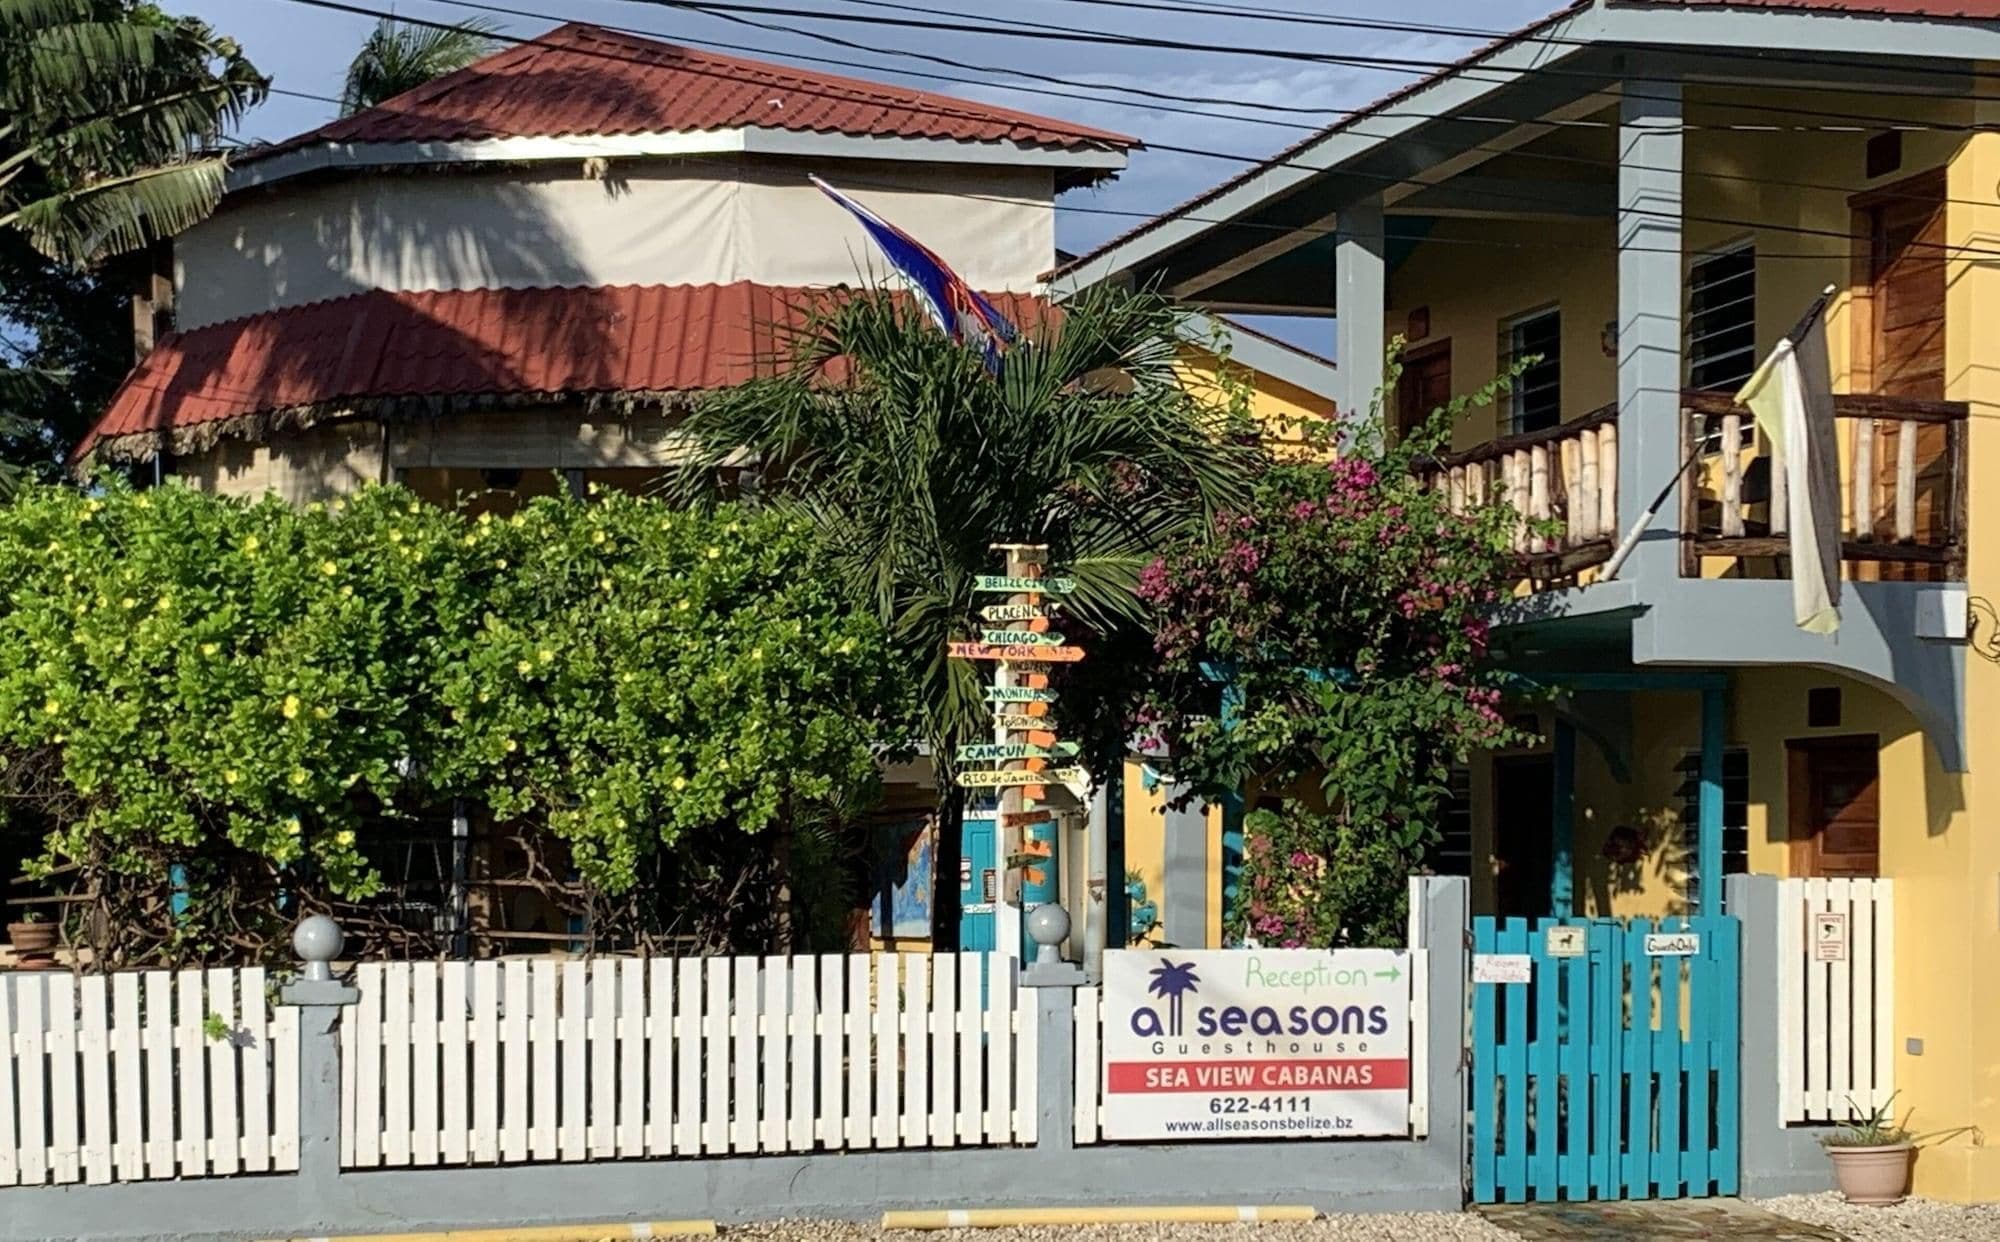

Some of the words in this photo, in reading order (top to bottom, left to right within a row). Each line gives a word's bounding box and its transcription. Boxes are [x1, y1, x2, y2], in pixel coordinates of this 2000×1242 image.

[985, 578, 1020, 589] BELIZE
[988, 631, 1038, 645] CHICAGO
[956, 645, 991, 657] NEW
[1000, 646, 1036, 657] YORK
[966, 745, 1026, 759] CANCUN
[963, 773, 988, 785] RIO
[1245, 956, 1368, 994] Reception
[1131, 993, 1183, 1037] all
[1197, 1005, 1387, 1037] seasons
[1152, 1041, 1368, 1055] Guesthouse
[1146, 1067, 1190, 1088] SEA
[1196, 1066, 1256, 1087] VIEW
[1262, 1064, 1373, 1086] CABANAS
[1210, 1097, 1312, 1115] 622-4111
[1166, 1117, 1353, 1133] www.allseasonsbelize.bz
